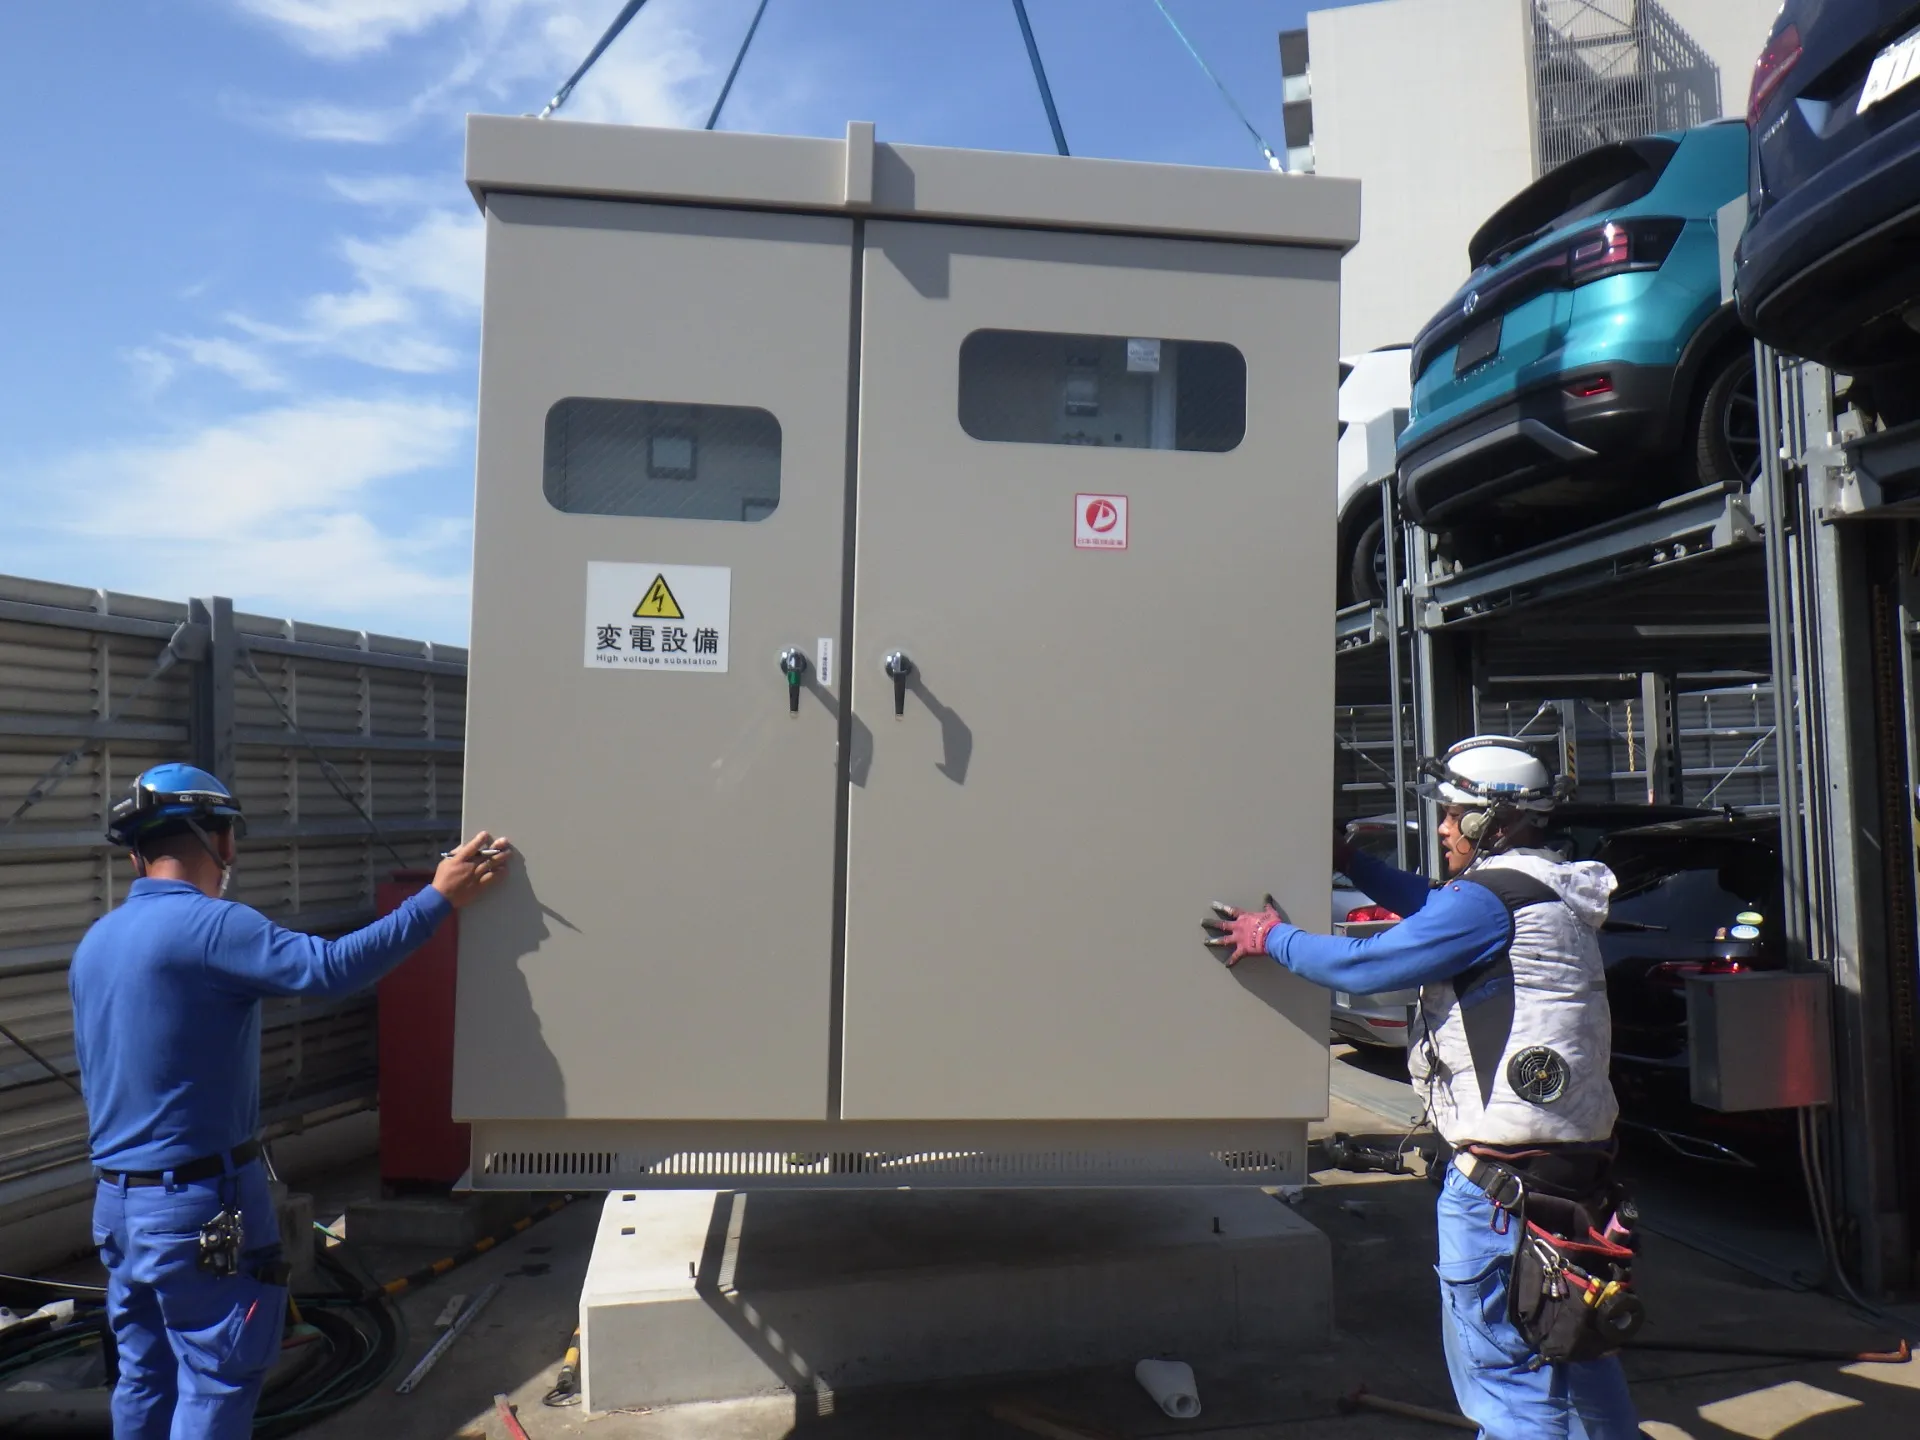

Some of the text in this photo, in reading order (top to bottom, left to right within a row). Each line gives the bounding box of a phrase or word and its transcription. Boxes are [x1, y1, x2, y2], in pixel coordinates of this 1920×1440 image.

[596, 623, 719, 655] 変電設備
[596, 654, 718, 666] High voltage substation
